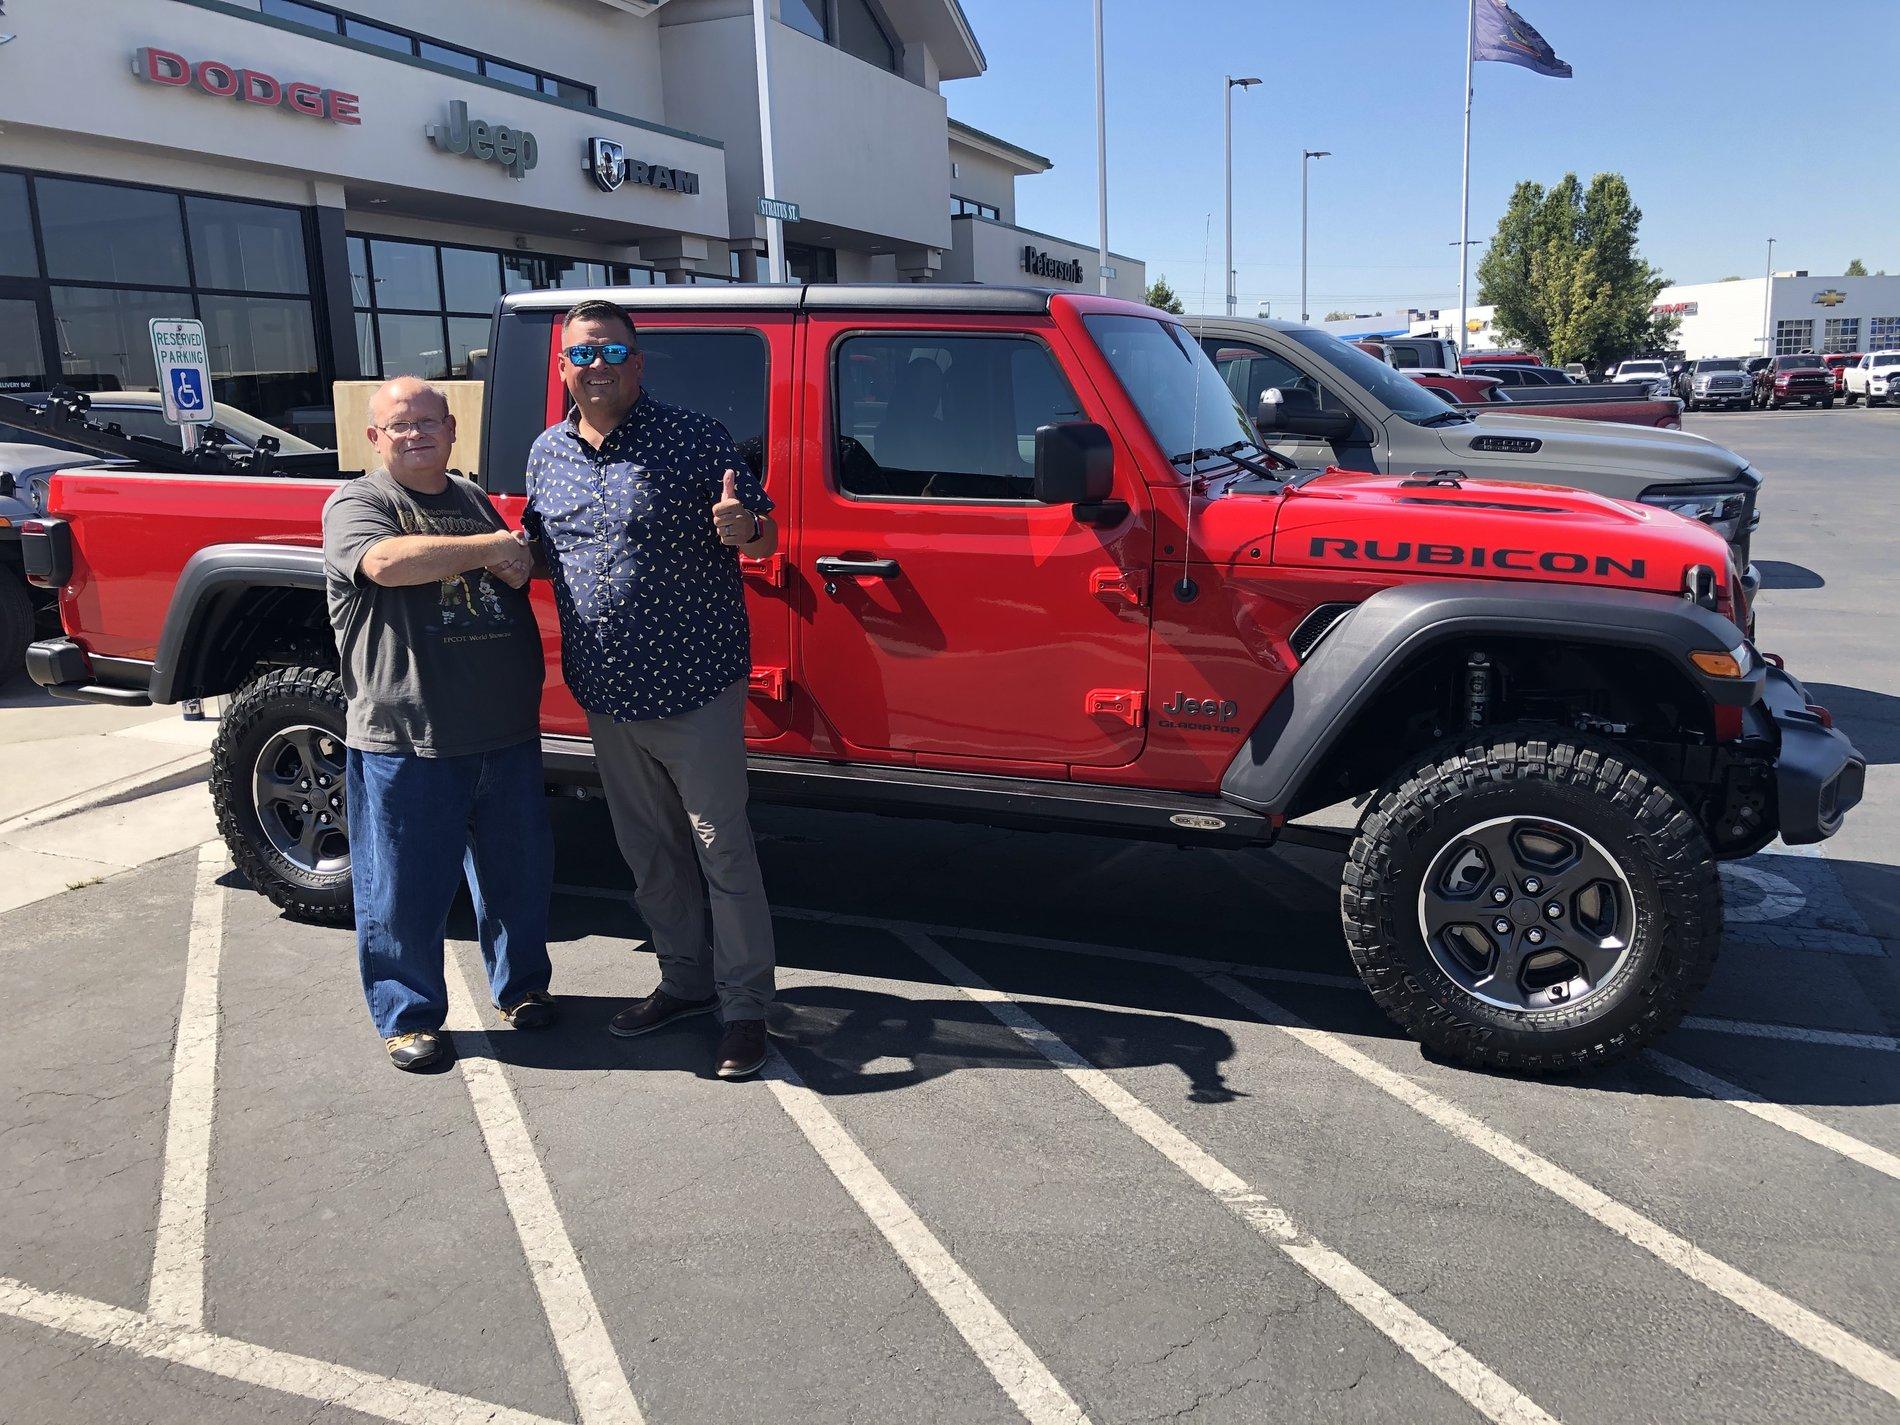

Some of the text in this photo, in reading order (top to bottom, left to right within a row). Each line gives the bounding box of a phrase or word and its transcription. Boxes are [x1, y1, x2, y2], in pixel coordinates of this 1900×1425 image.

[136, 46, 361, 126] DODGE
[433, 99, 538, 181] Jeep
[624, 157, 699, 195] RAM
[760, 199, 787, 219] STRATUS
[1024, 245, 1084, 283] Peterson's
[156, 332, 202, 346] RESERVED
[160, 350, 203, 364] PARKING
[1310, 536, 1646, 580] RUBICON
[1162, 690, 1238, 722] Jeep
[1158, 720, 1241, 734] GLADIATOR
